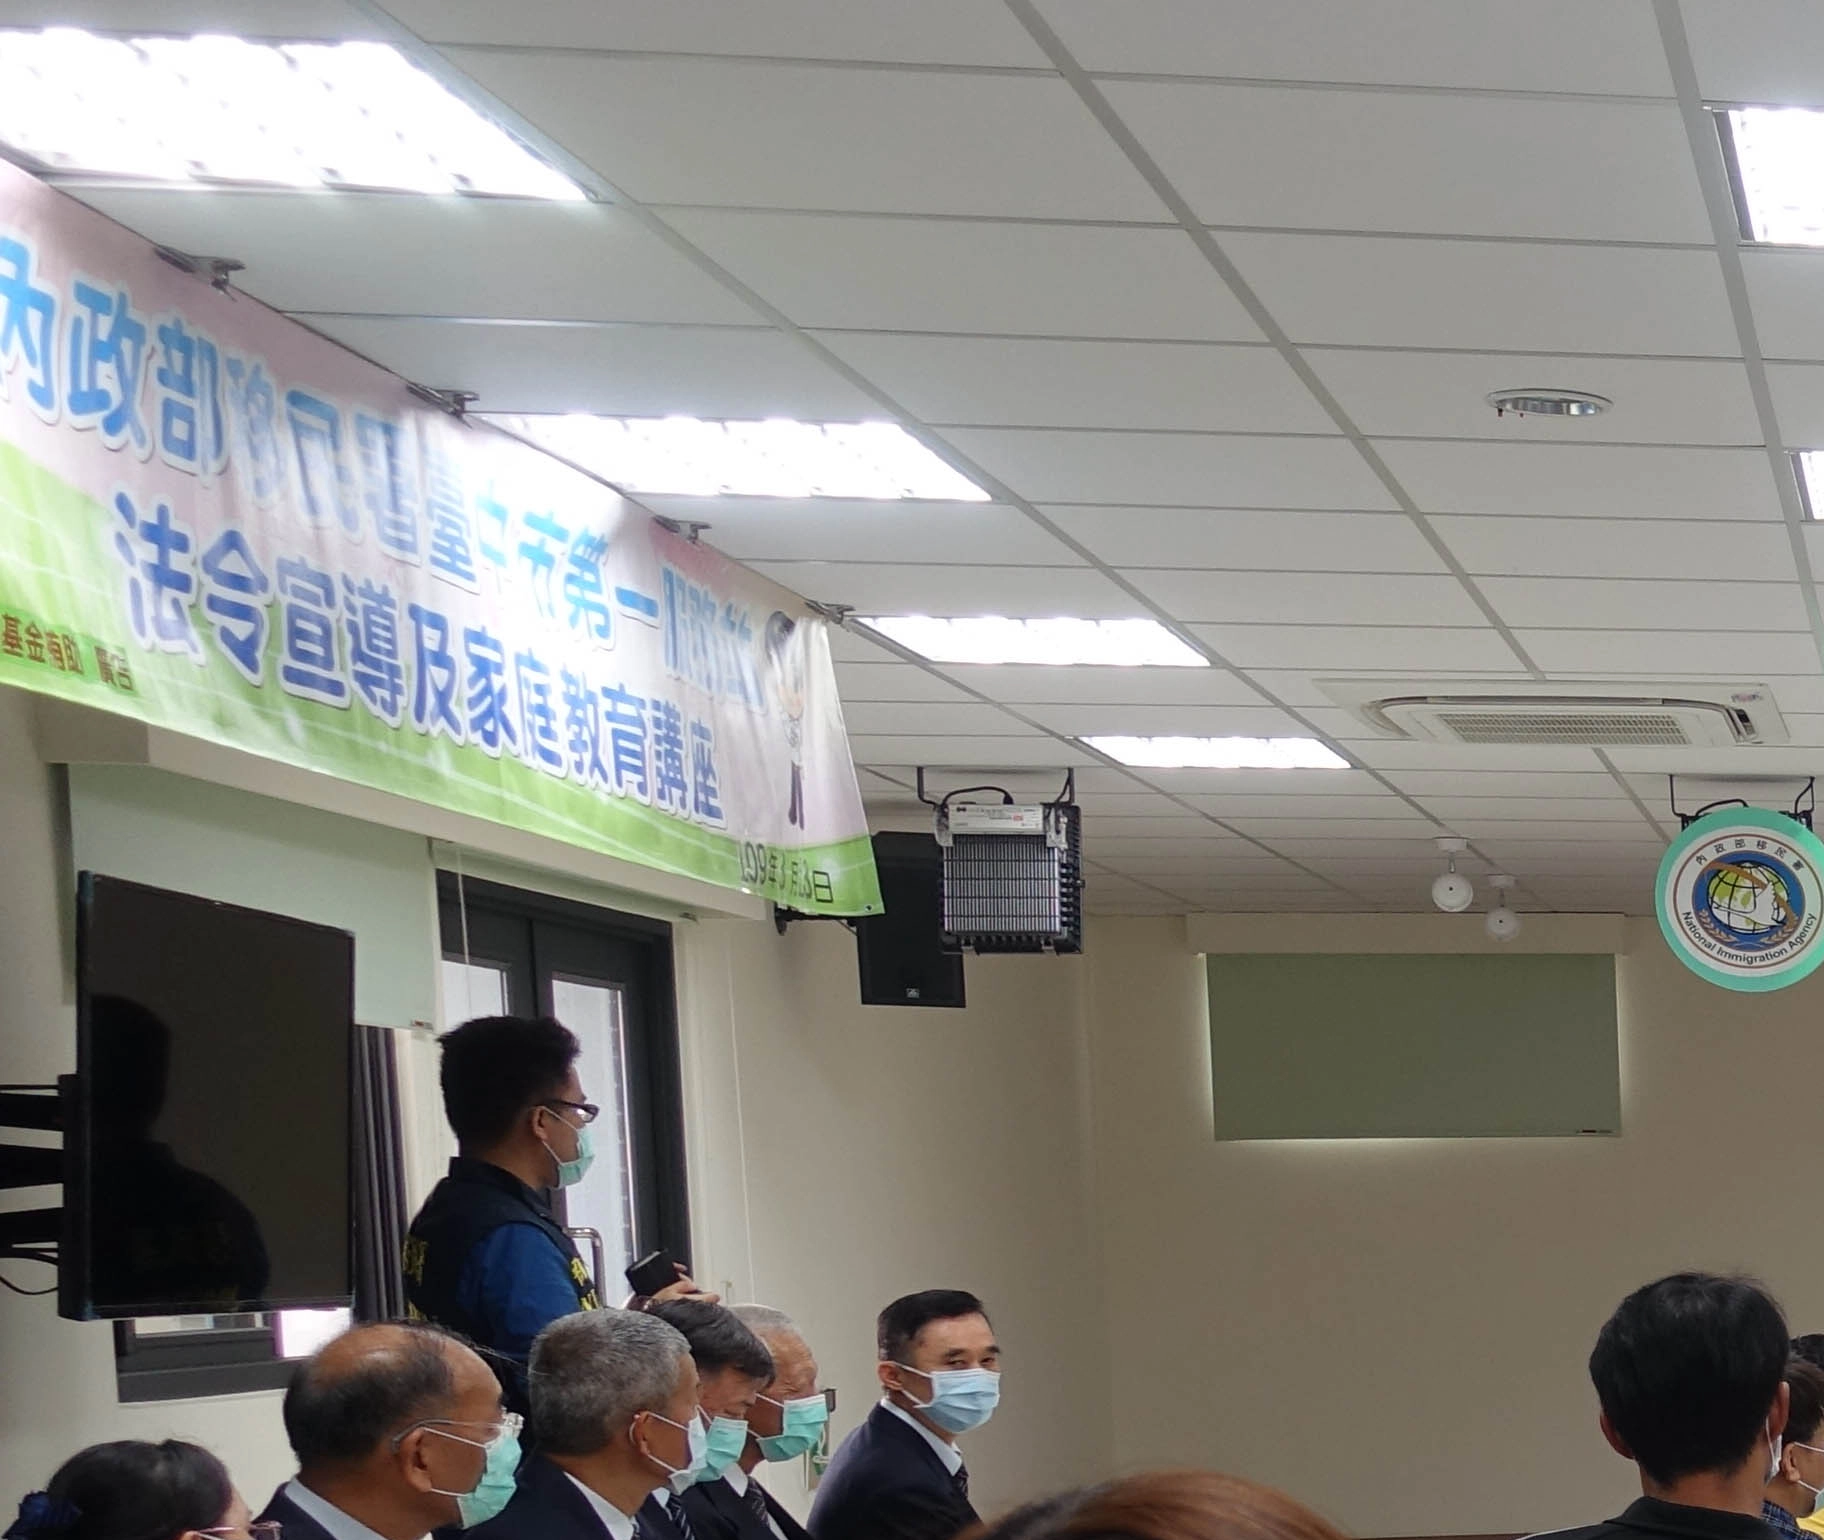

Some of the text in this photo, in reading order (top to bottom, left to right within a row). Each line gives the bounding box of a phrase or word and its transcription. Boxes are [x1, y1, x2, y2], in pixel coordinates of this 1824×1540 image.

[115, 491, 723, 820] 法令宣導及家庭教育講座
[1682, 911, 1817, 965] National Immigration Agency
